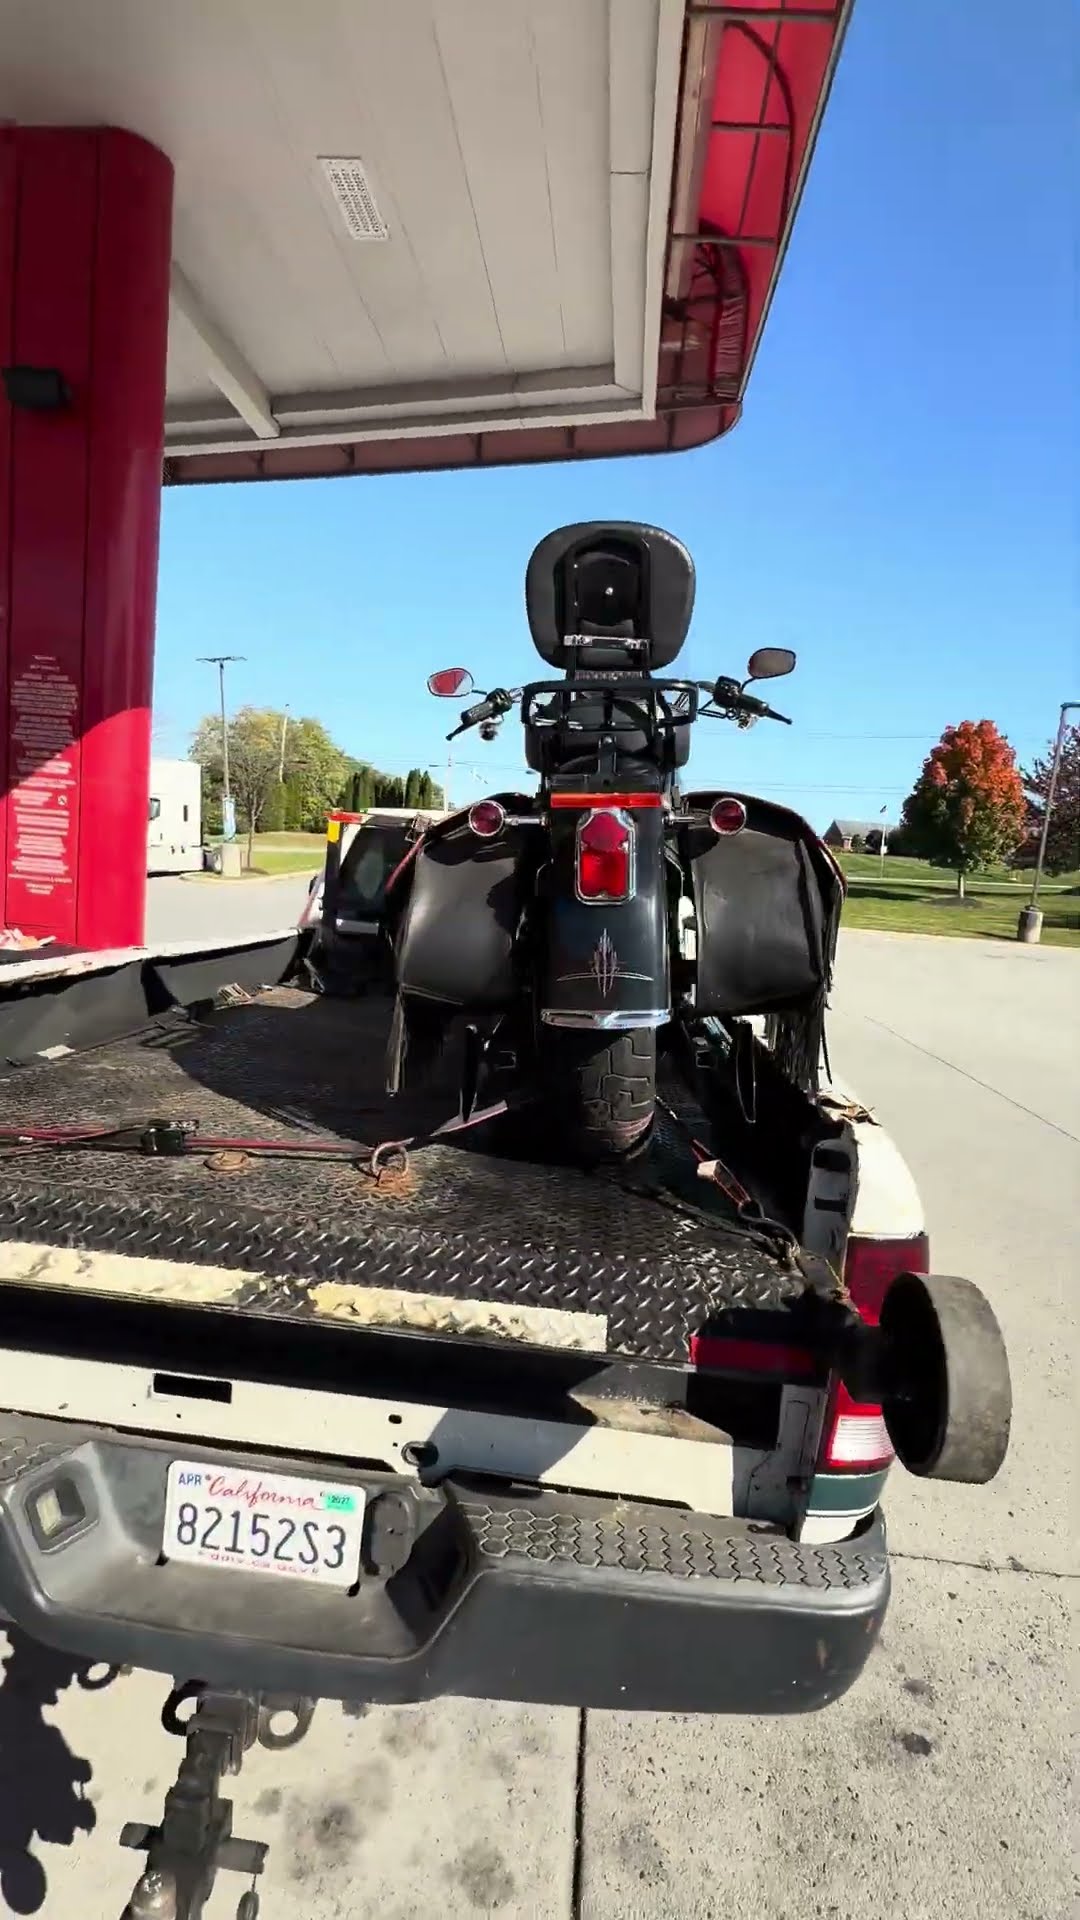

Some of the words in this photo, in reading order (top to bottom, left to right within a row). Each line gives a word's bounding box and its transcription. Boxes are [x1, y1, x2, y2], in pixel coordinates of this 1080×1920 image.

[178, 1472, 202, 1486] APR
[207, 1475, 323, 1511] California
[176, 1502, 347, 1570] 82152S3
